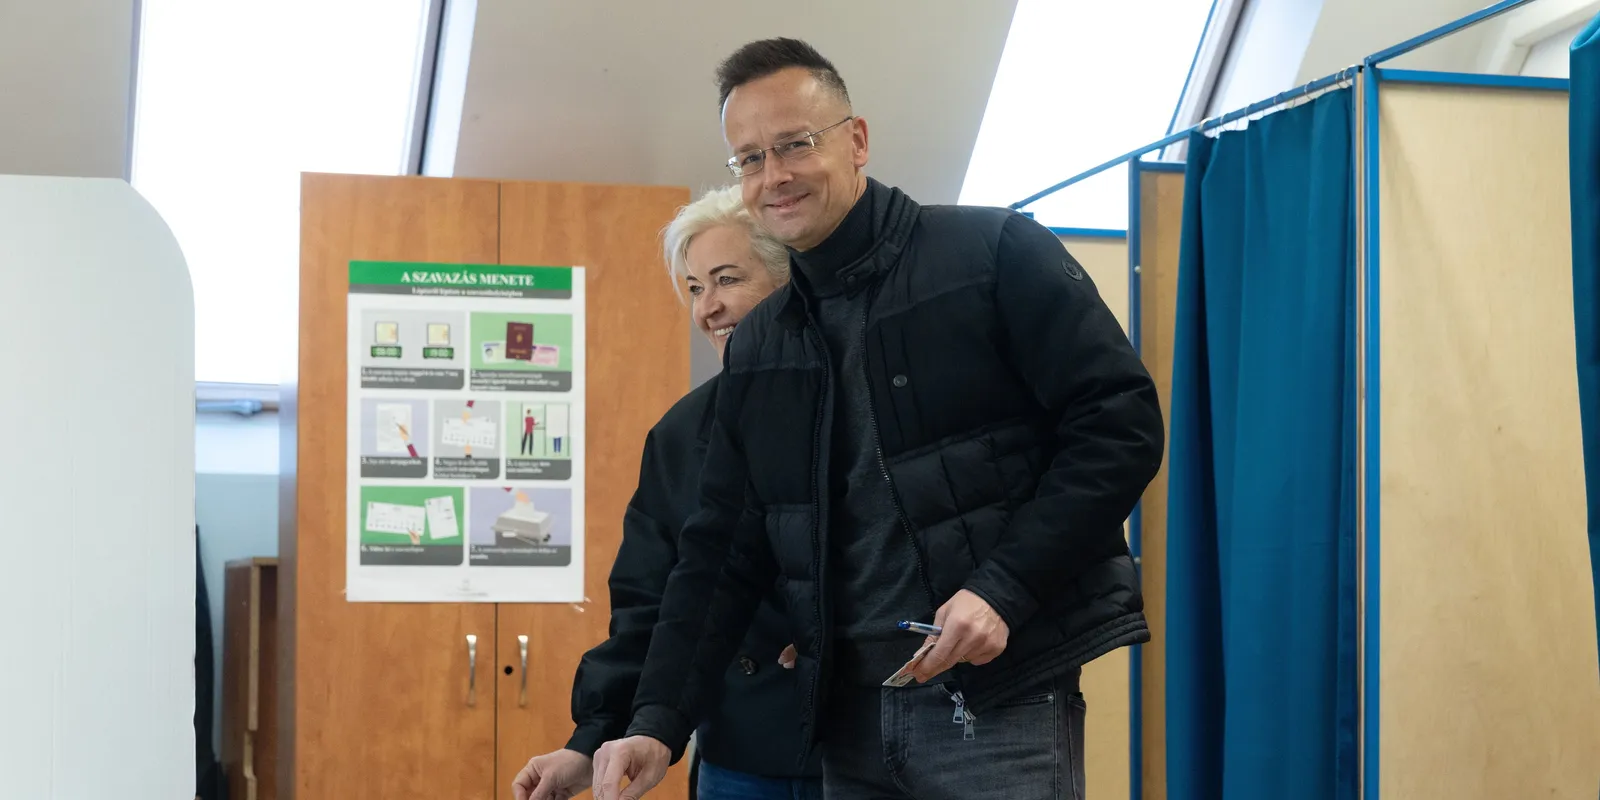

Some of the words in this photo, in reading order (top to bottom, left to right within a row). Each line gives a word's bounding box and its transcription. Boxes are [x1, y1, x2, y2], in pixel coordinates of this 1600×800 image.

[400, 271, 411, 283] A
[411, 270, 478, 285] SZAVAZÁS
[480, 273, 534, 286] MENETE
